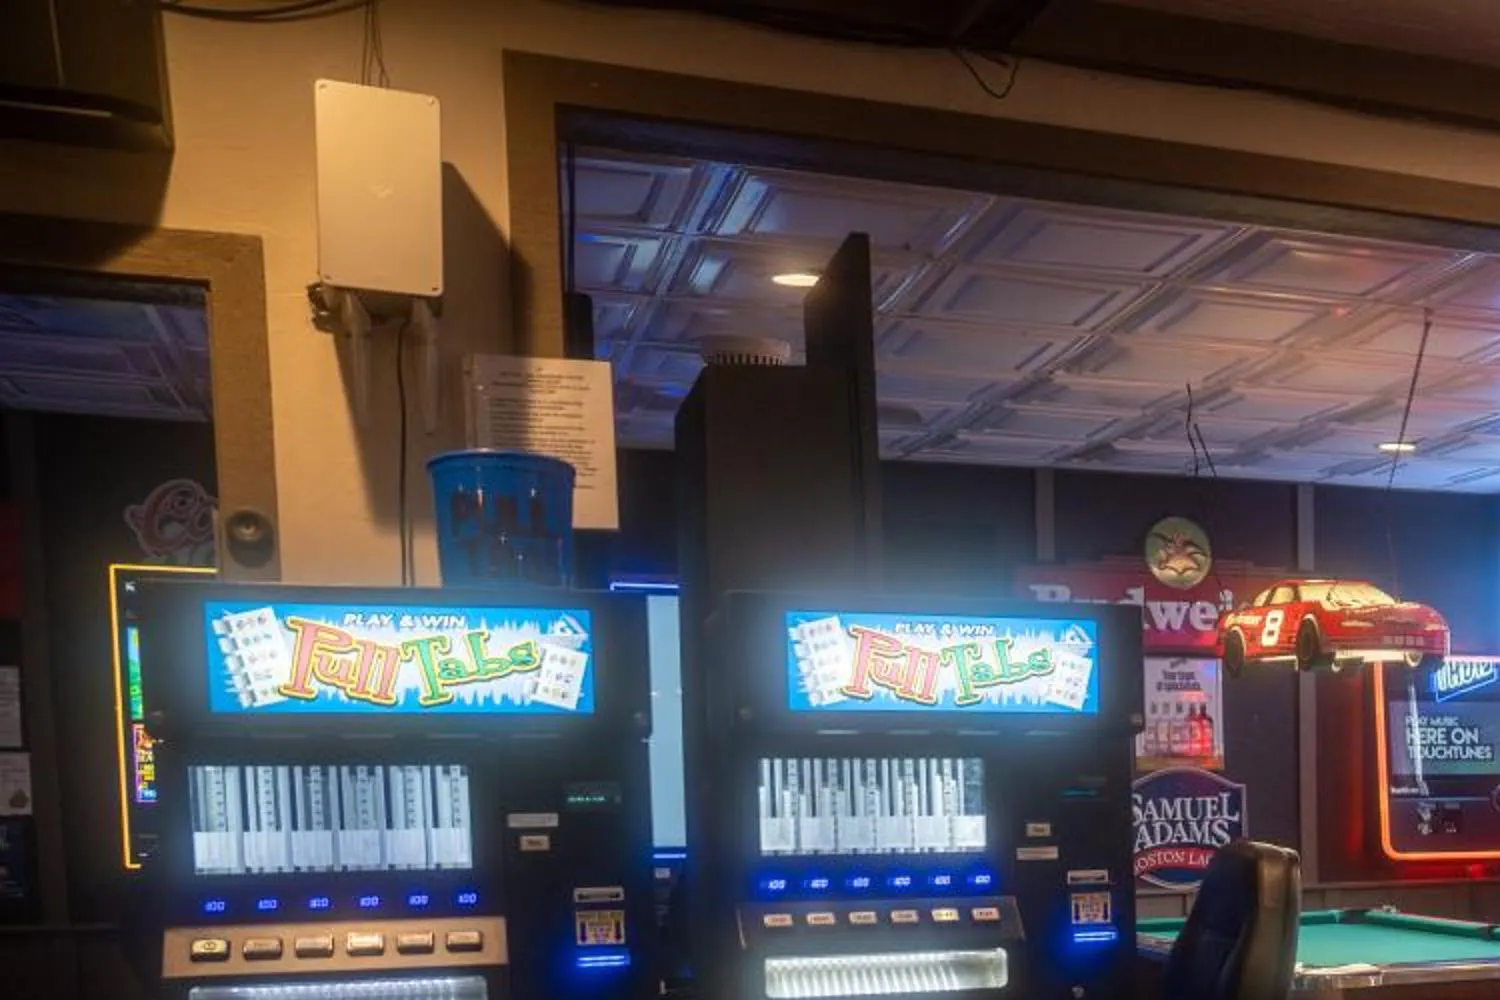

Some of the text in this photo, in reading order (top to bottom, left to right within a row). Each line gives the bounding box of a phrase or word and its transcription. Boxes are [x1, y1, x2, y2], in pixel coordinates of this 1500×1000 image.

[343, 612, 392, 627] PLAY
[418, 614, 466, 628] WIN
[895, 622, 933, 635] PLAY
[956, 624, 996, 637] WIN
[1260, 609, 1286, 648] 8
[278, 615, 543, 706] Pull Tabs
[840, 624, 1056, 706] Pull Tabs
[1406, 727, 1480, 745] HERE ON
[1408, 745, 1493, 760] TOUCHTUNES
[1132, 791, 1240, 827] SAMUEL
[1134, 819, 1232, 851] ADAMS
[1134, 850, 1186, 872] OSTON
